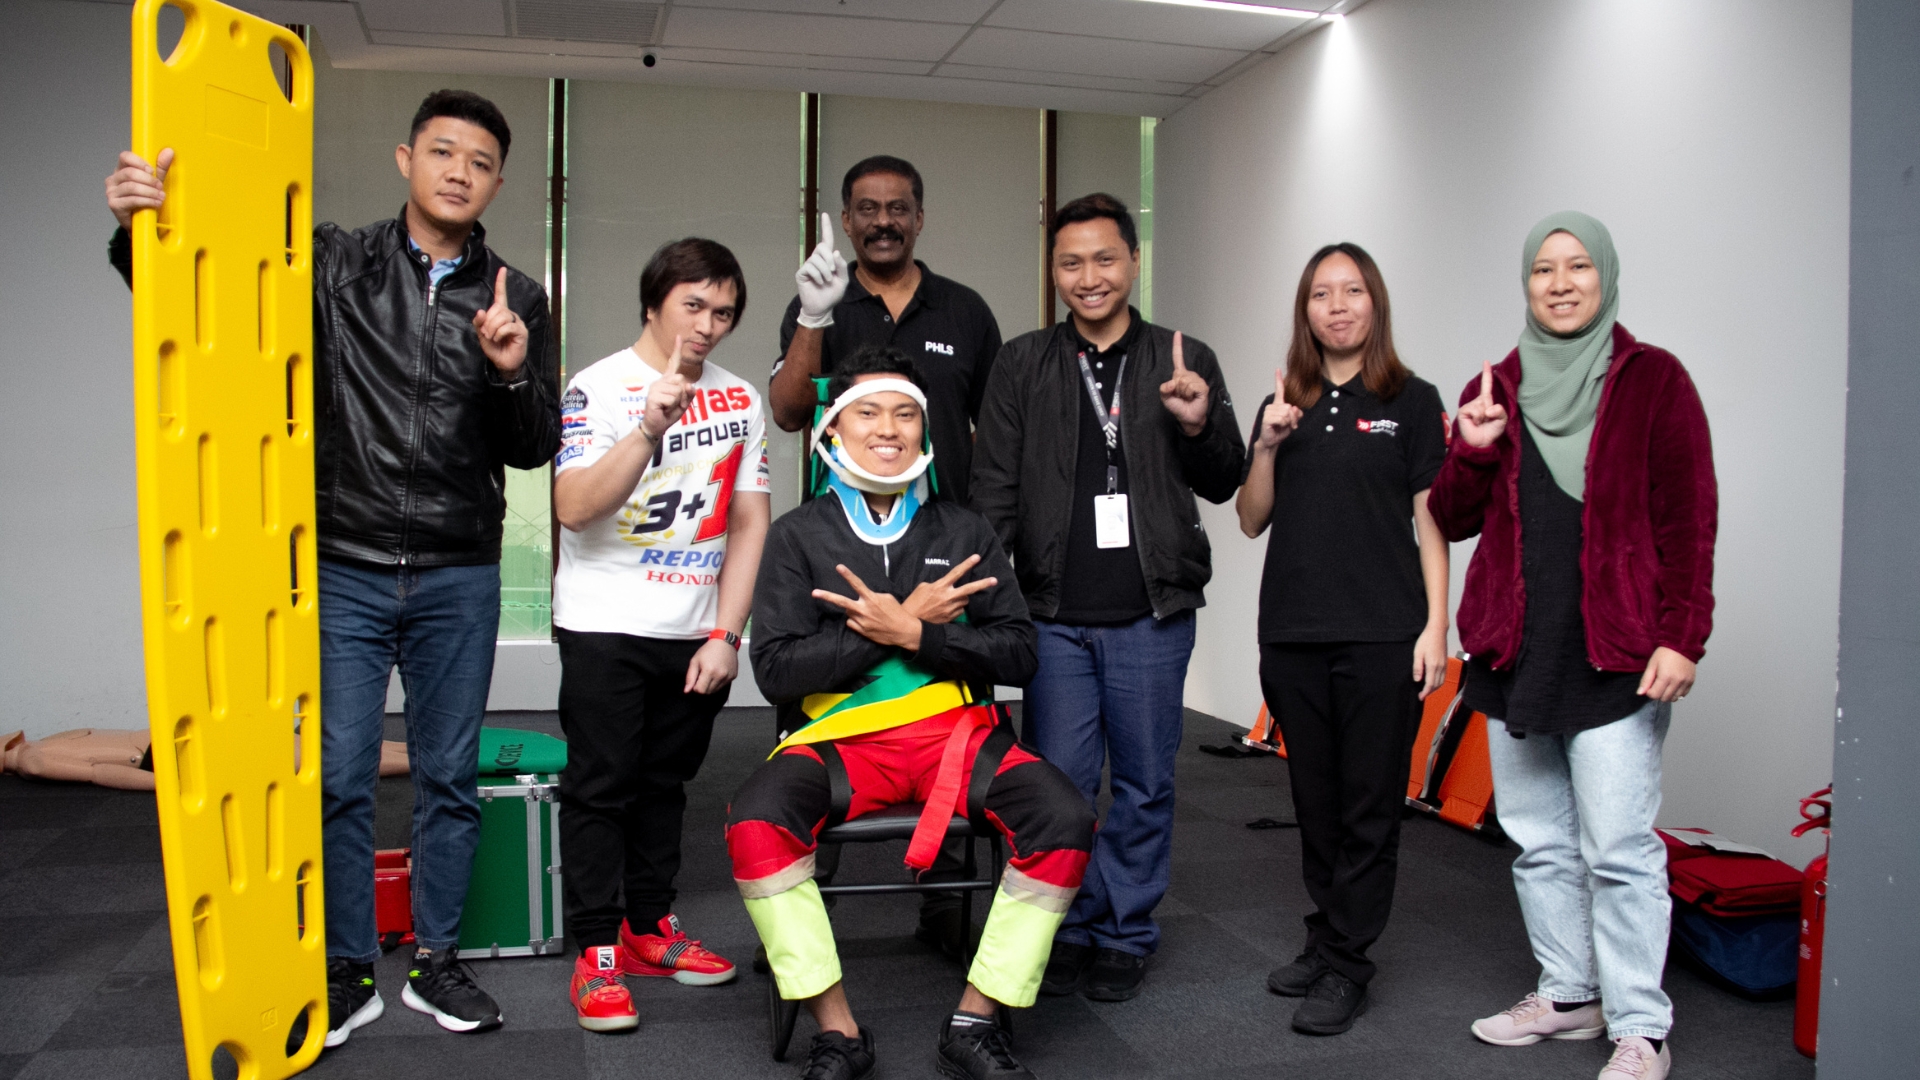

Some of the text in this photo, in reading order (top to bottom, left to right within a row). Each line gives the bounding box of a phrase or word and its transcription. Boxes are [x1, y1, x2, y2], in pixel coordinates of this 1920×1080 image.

[925, 341, 954, 356] PHLS
[1370, 419, 1399, 430] FIRST
[561, 446, 583, 462] GAS
[652, 463, 694, 479] WORLD
